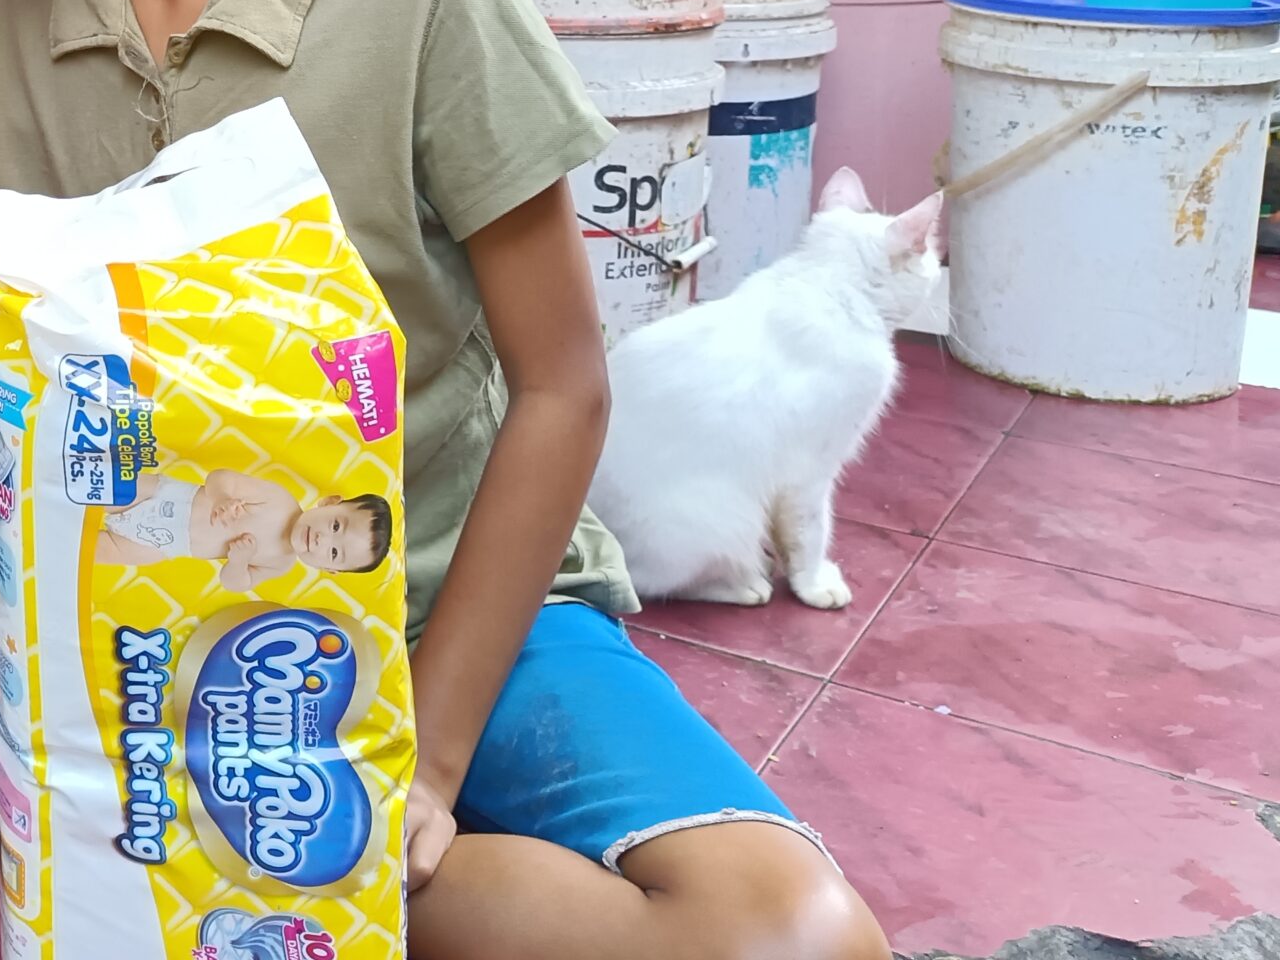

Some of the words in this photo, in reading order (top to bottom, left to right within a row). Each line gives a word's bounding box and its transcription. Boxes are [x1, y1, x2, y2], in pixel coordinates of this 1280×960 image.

[111, 385, 135, 429] Tipe
[348, 353, 378, 428] HEMAT!
[70, 409, 108, 455] 24
[134, 401, 153, 444] Popok
[117, 434, 136, 481] Celana
[139, 444, 157, 466] Bayi
[118, 627, 169, 726] X-tra
[204, 691, 253, 801] pants
[118, 728, 174, 864] Kering
